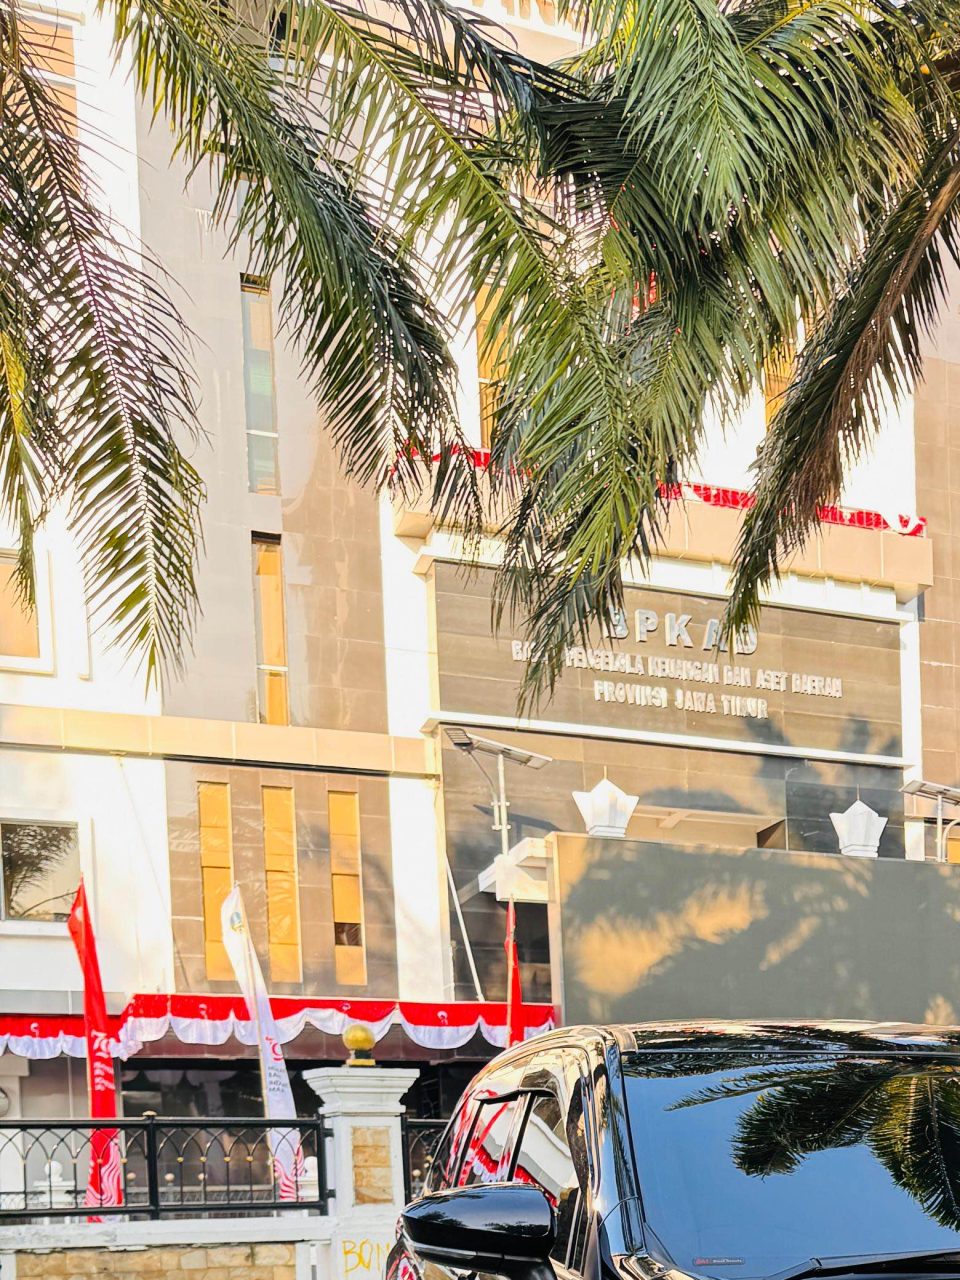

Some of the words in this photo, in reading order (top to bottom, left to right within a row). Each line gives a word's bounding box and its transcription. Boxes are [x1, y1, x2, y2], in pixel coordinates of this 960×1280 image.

[564, 645, 645, 675] PENGELOLA
[647, 656, 720, 684] KEUANGAN
[723, 664, 751, 687] DAN
[755, 668, 789, 692] ASET
[791, 673, 843, 698] DAERAH
[594, 680, 668, 708] PROVINSI
[674, 687, 717, 714] JAWA
[721, 694, 769, 719] TIMUR
